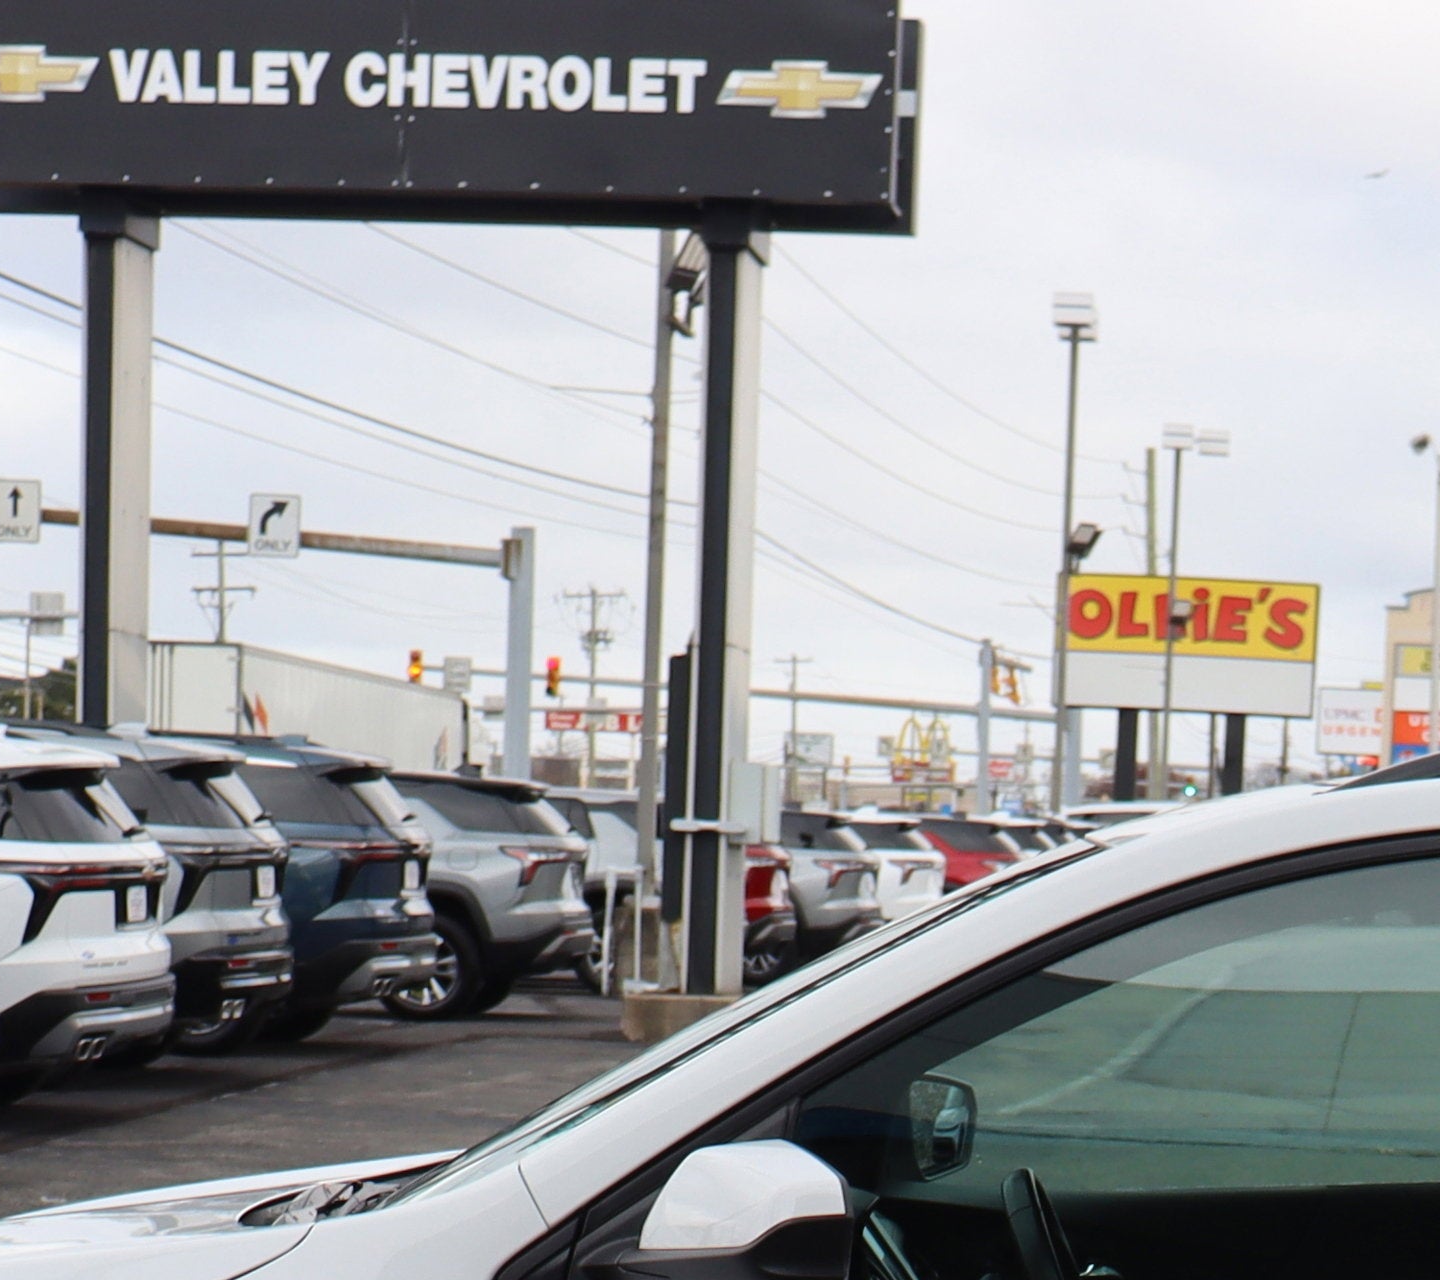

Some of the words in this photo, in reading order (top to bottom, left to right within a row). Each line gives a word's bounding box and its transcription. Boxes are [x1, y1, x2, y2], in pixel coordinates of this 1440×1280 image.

[109, 48, 330, 105] VALLEY
[344, 52, 708, 114] CHEVROLET
[255, 539, 291, 551] ONLY
